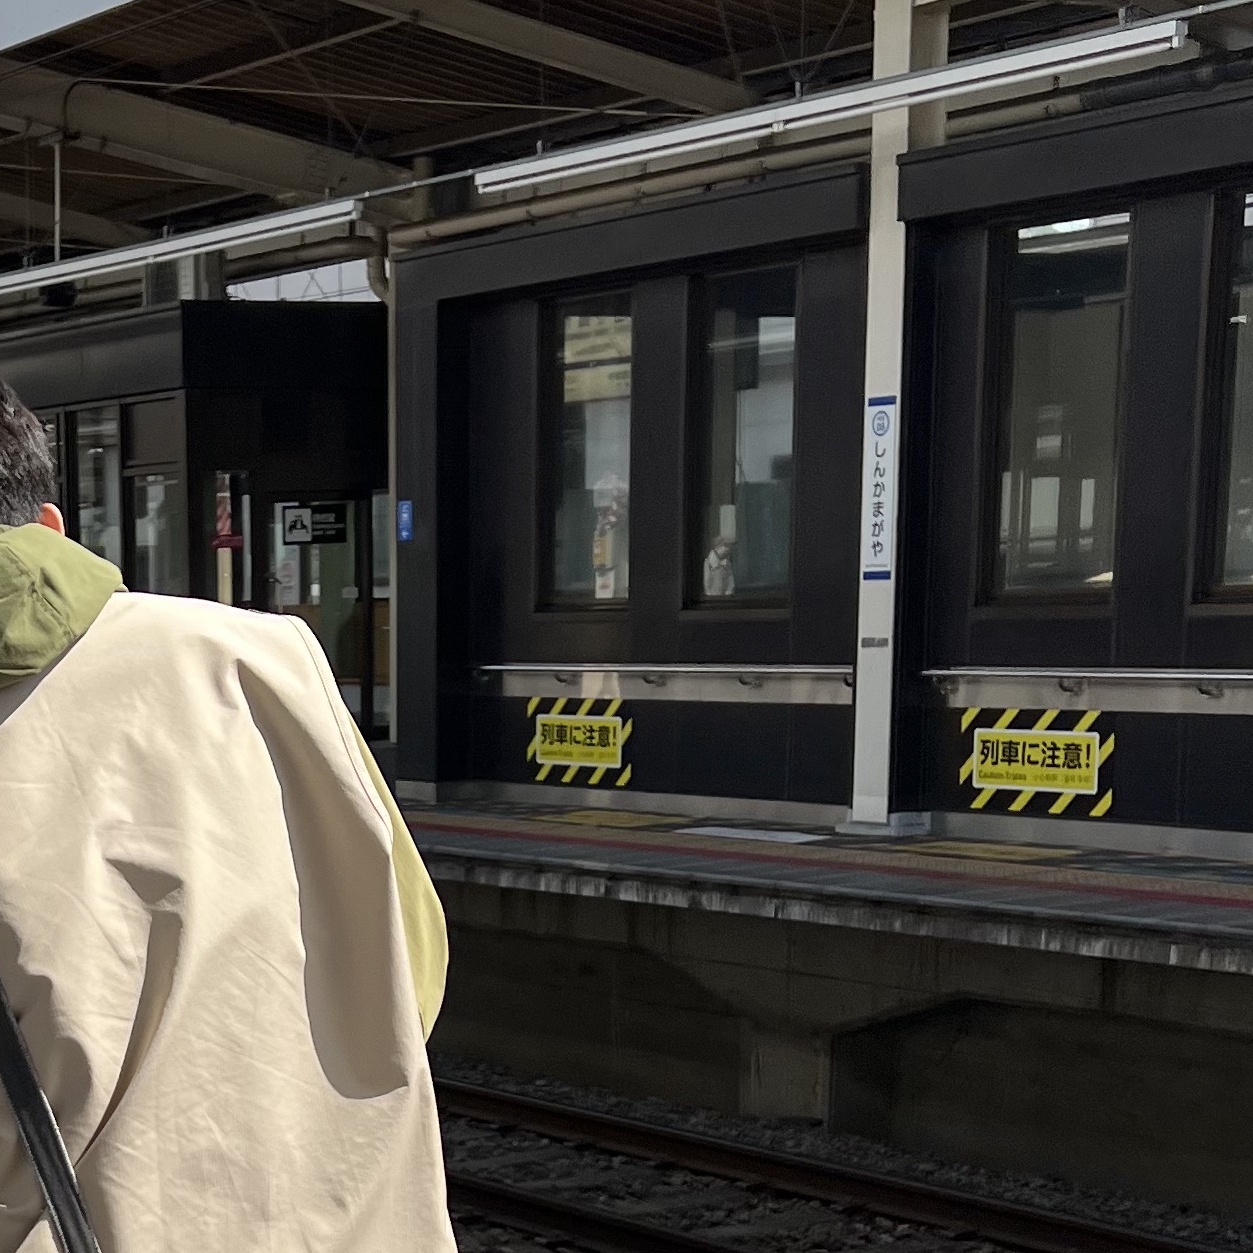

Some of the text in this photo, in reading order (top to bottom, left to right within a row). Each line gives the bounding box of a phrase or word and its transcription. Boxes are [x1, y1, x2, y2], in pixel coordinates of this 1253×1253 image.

[871, 441, 887, 558] しんかまがや
[541, 723, 617, 747] 列車に注意!
[980, 739, 1092, 769] 列車に注意!
